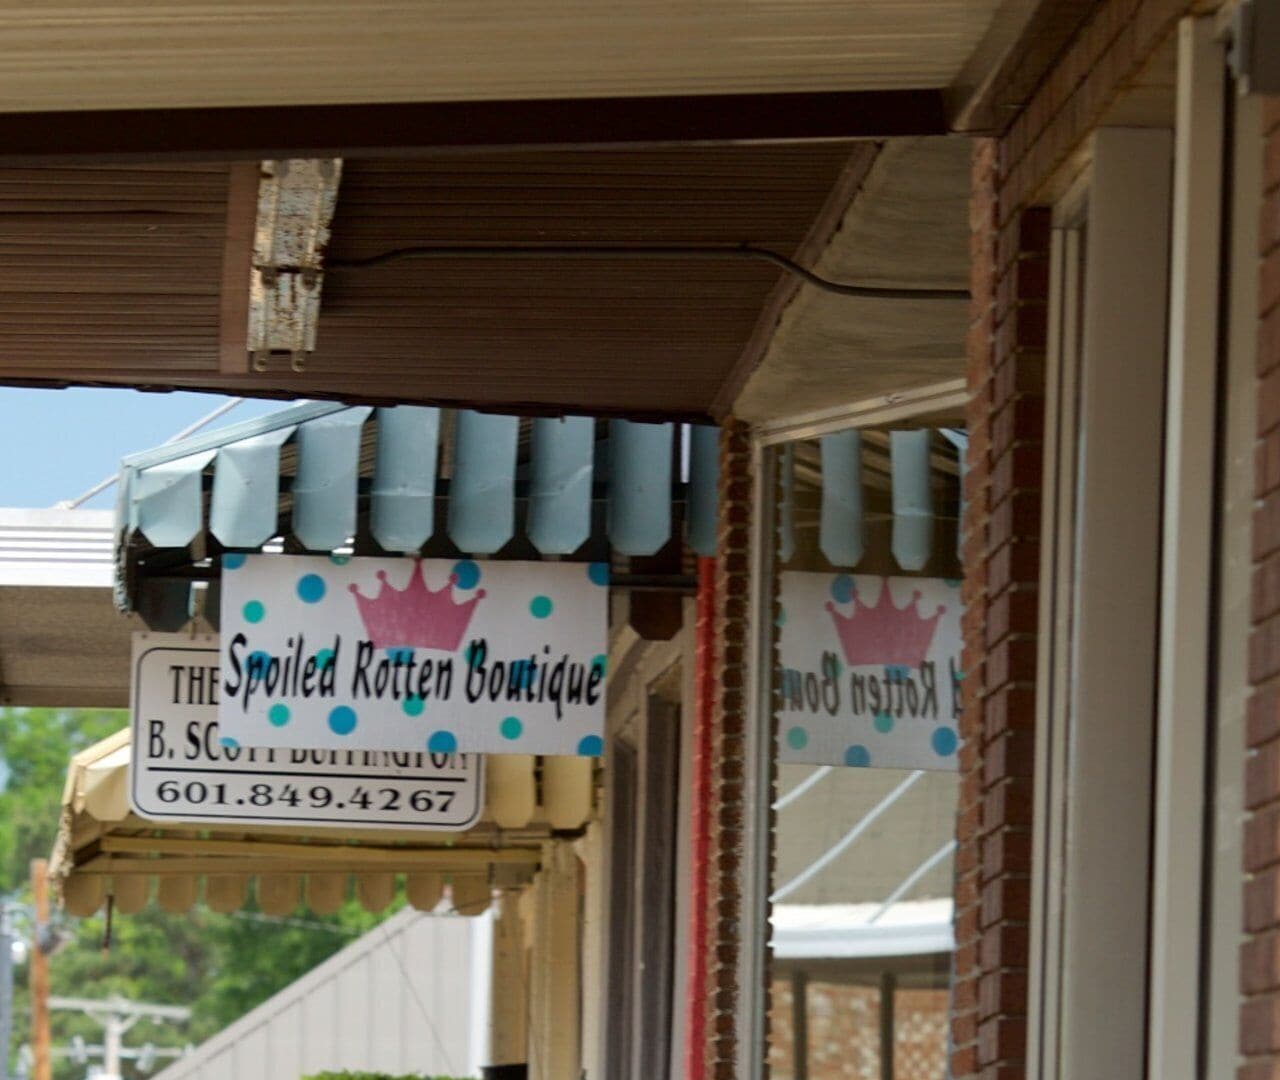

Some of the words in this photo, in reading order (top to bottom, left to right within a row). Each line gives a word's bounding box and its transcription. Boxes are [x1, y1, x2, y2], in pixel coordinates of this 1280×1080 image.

[224, 633, 341, 713] Spoiled
[352, 639, 454, 701] Rotten
[465, 638, 603, 721] Boutique
[147, 720, 175, 760] B.
[156, 780, 457, 813] 601.849.4267
